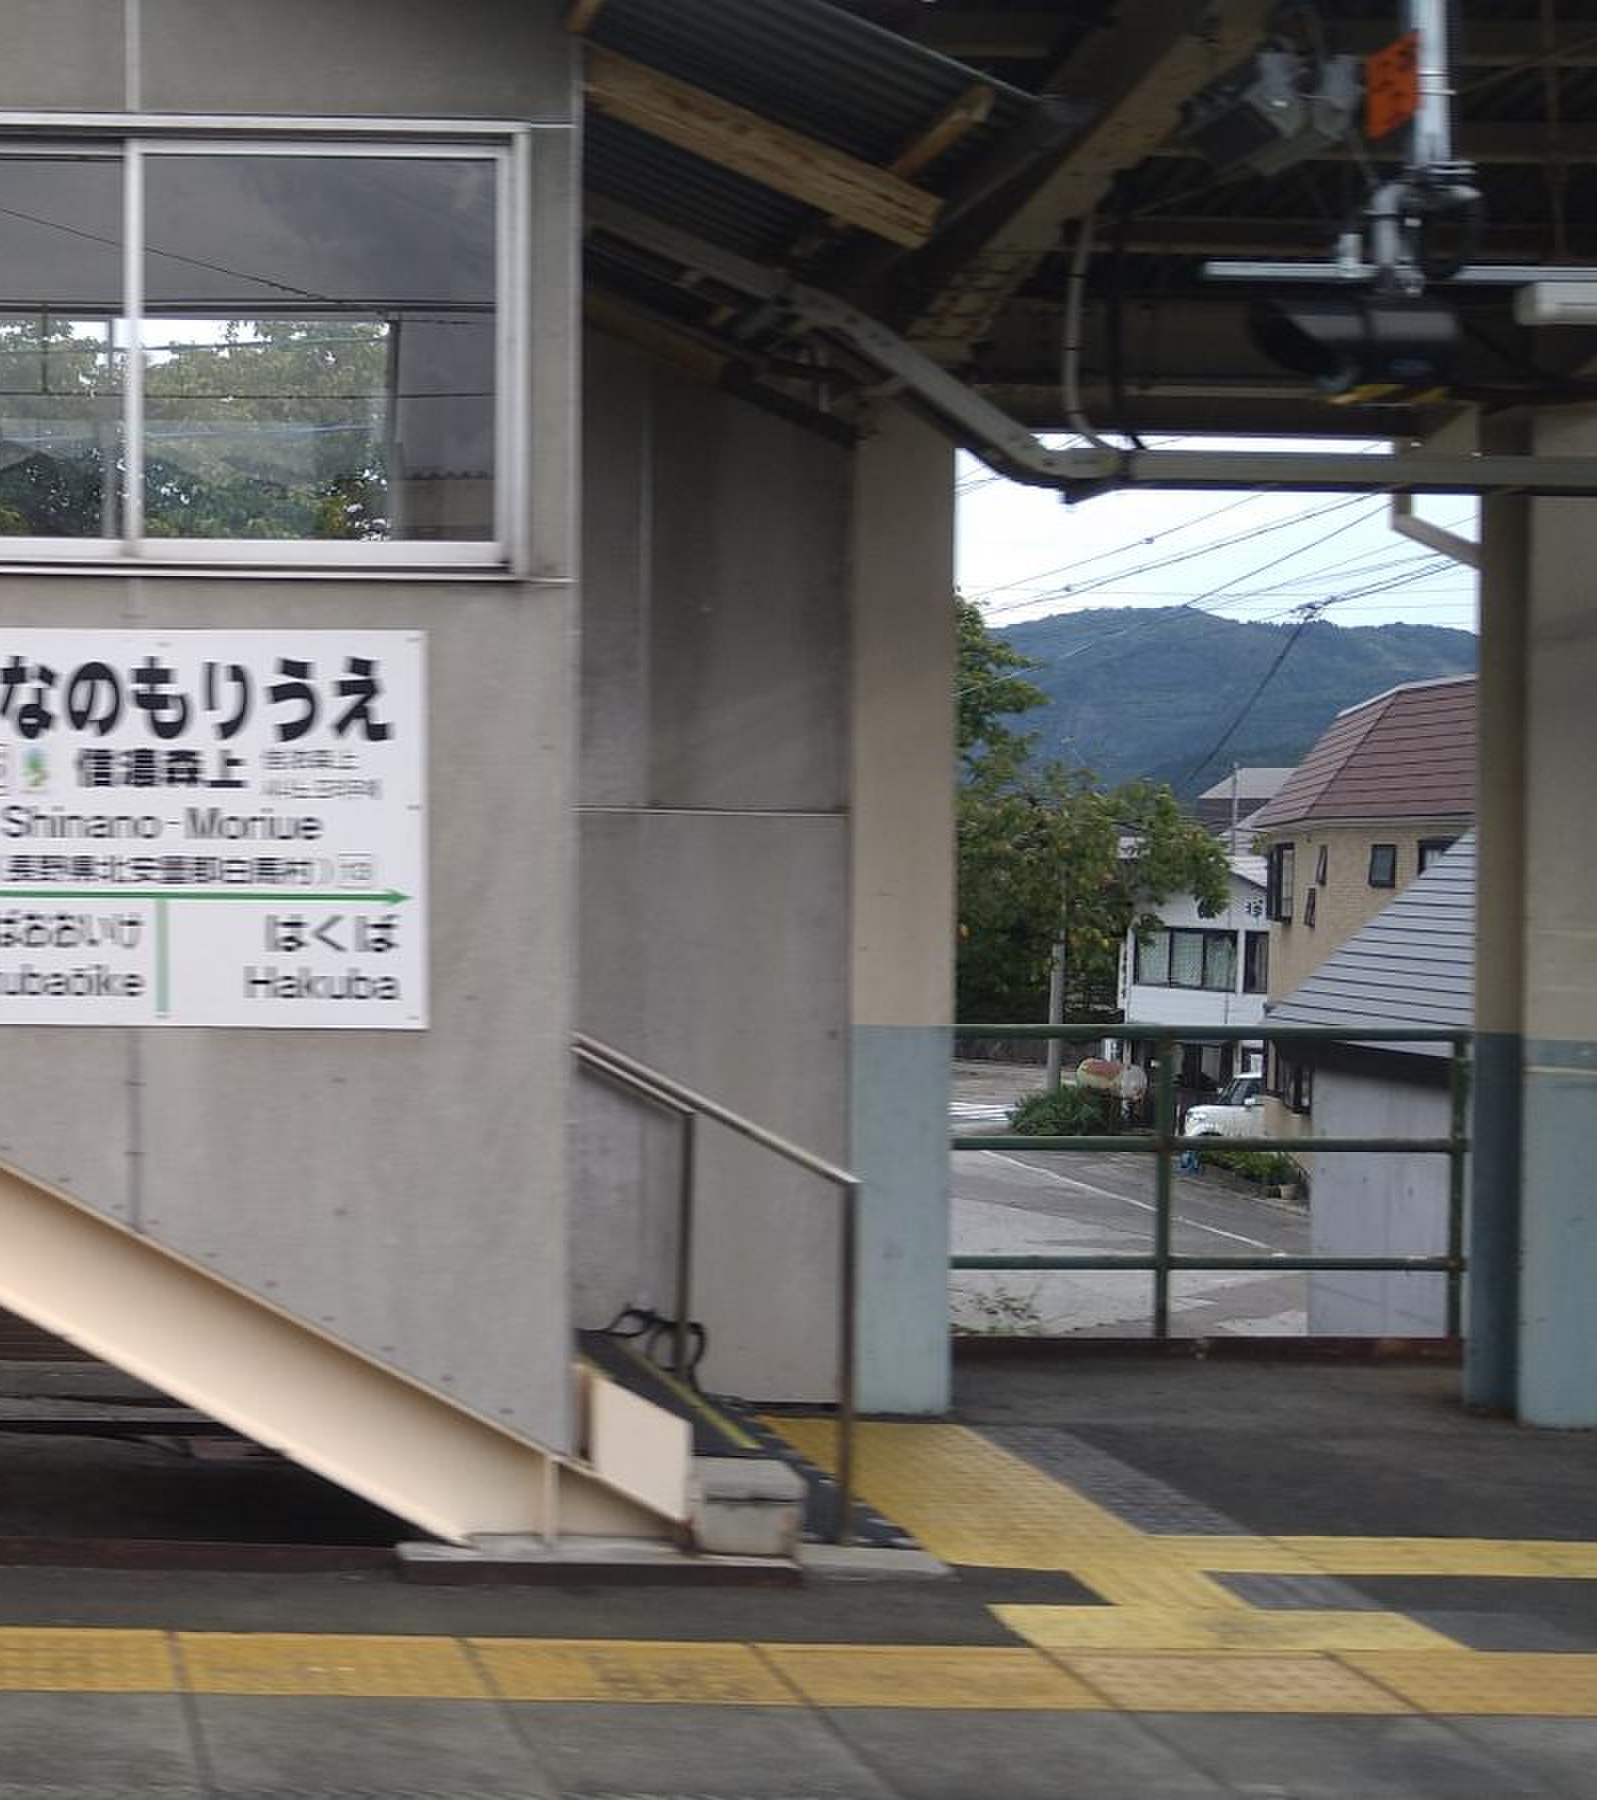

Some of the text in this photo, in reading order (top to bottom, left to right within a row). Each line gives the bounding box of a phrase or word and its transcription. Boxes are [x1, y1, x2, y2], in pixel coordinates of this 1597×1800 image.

[74, 748, 247, 789] 信濃森上
[1, 804, 324, 841] Shinano-Moriue
[265, 914, 401, 952] はくば
[243, 966, 402, 1000] Hakuba
